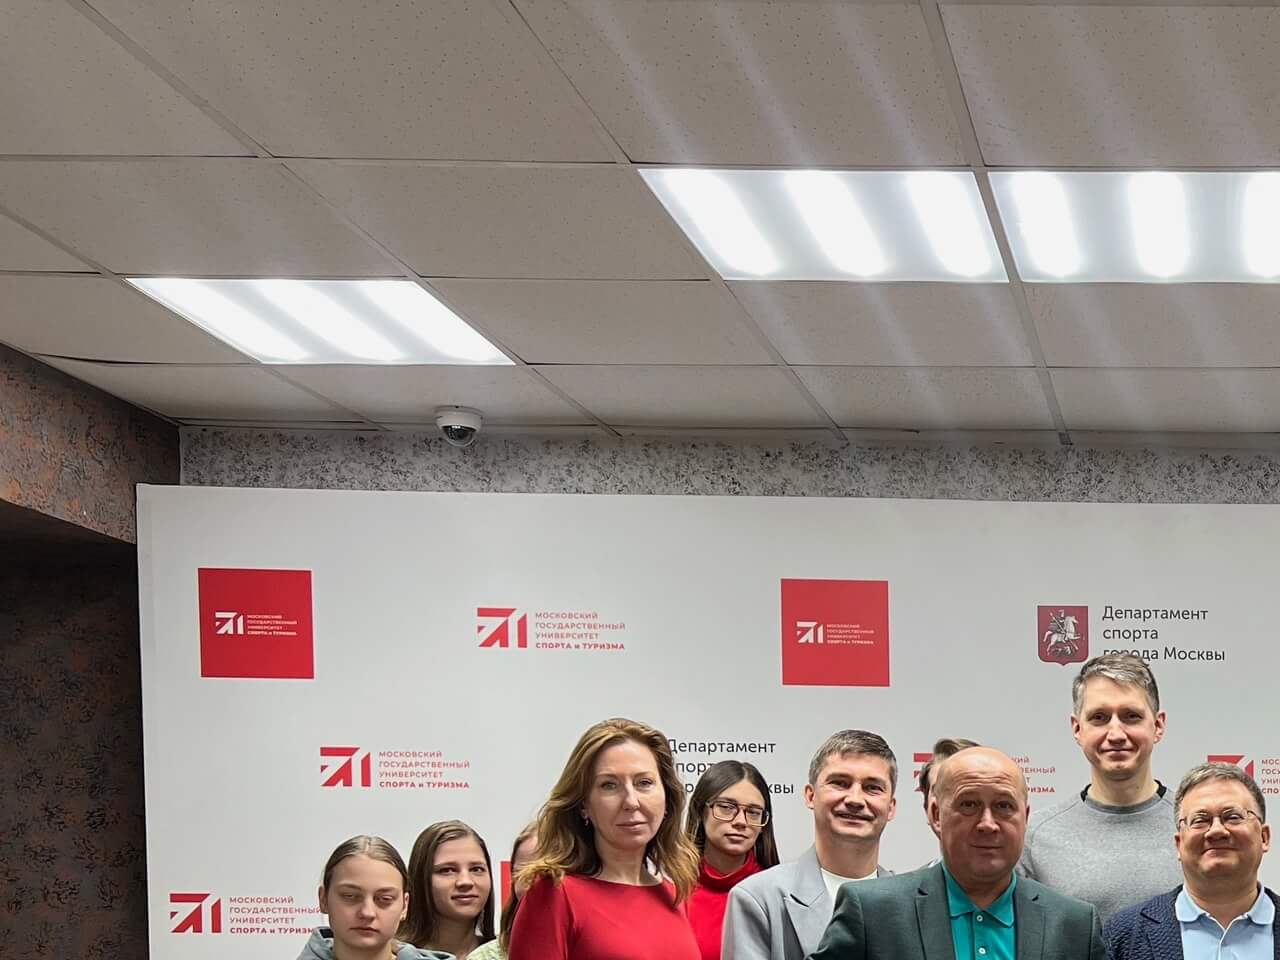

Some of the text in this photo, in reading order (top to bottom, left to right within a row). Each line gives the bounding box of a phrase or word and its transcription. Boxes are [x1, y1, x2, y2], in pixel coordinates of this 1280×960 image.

[535, 612, 598, 620] МОСКОВСКИЙ
[1102, 606, 1208, 622] Департамент
[535, 622, 626, 630] ГОСУДАРСТВЕННЫЙ
[535, 632, 598, 640] УНИВЕРСИТЕТ
[1103, 628, 1158, 642] спорта
[1163, 646, 1225, 660] Москвы
[668, 739, 776, 755] Департамент
[379, 750, 442, 758] МОСКОВСКИЙ
[379, 760, 470, 768] ГОСУДАРСТВЕННЫЙ
[229, 896, 294, 904] МОСКОВСКИЙ
[230, 906, 321, 914] ГОСУДАРСТВЕННЫЙ
